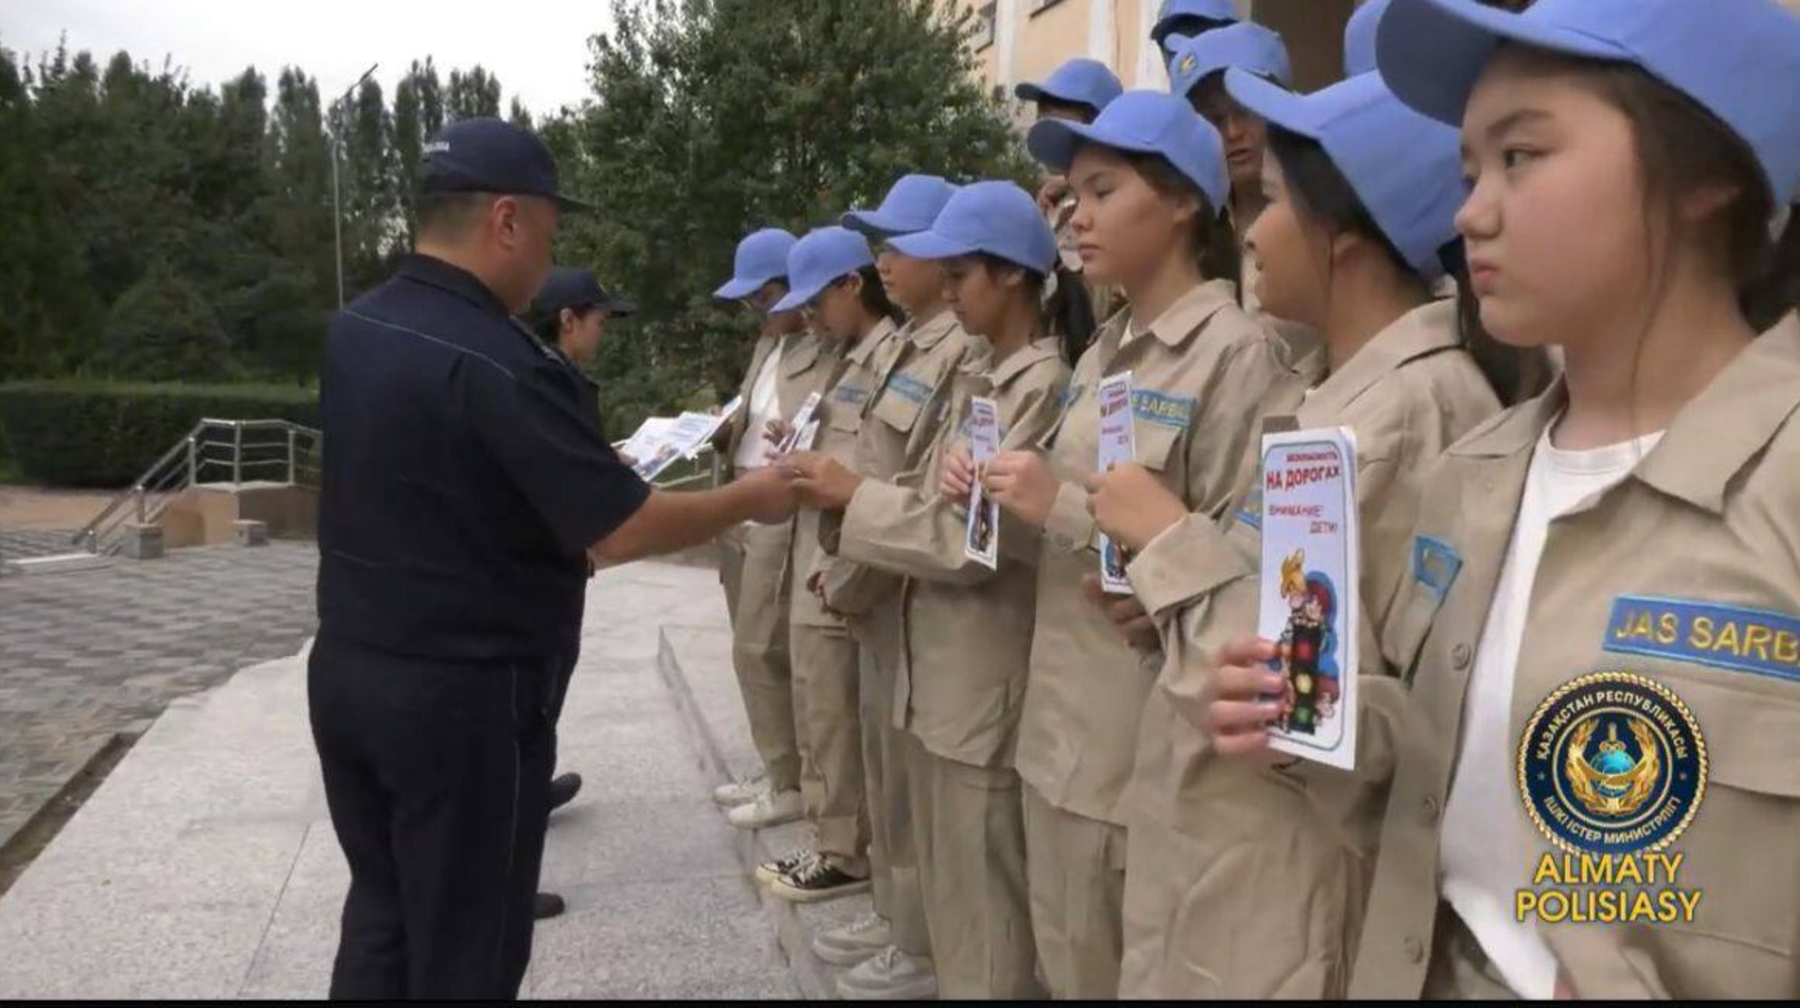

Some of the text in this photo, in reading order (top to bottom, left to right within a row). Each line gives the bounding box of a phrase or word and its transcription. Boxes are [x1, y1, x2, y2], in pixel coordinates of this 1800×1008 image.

[1266, 466, 1340, 492] НА ДОРОГАХ
[1616, 612, 1800, 666] JAS SARB
